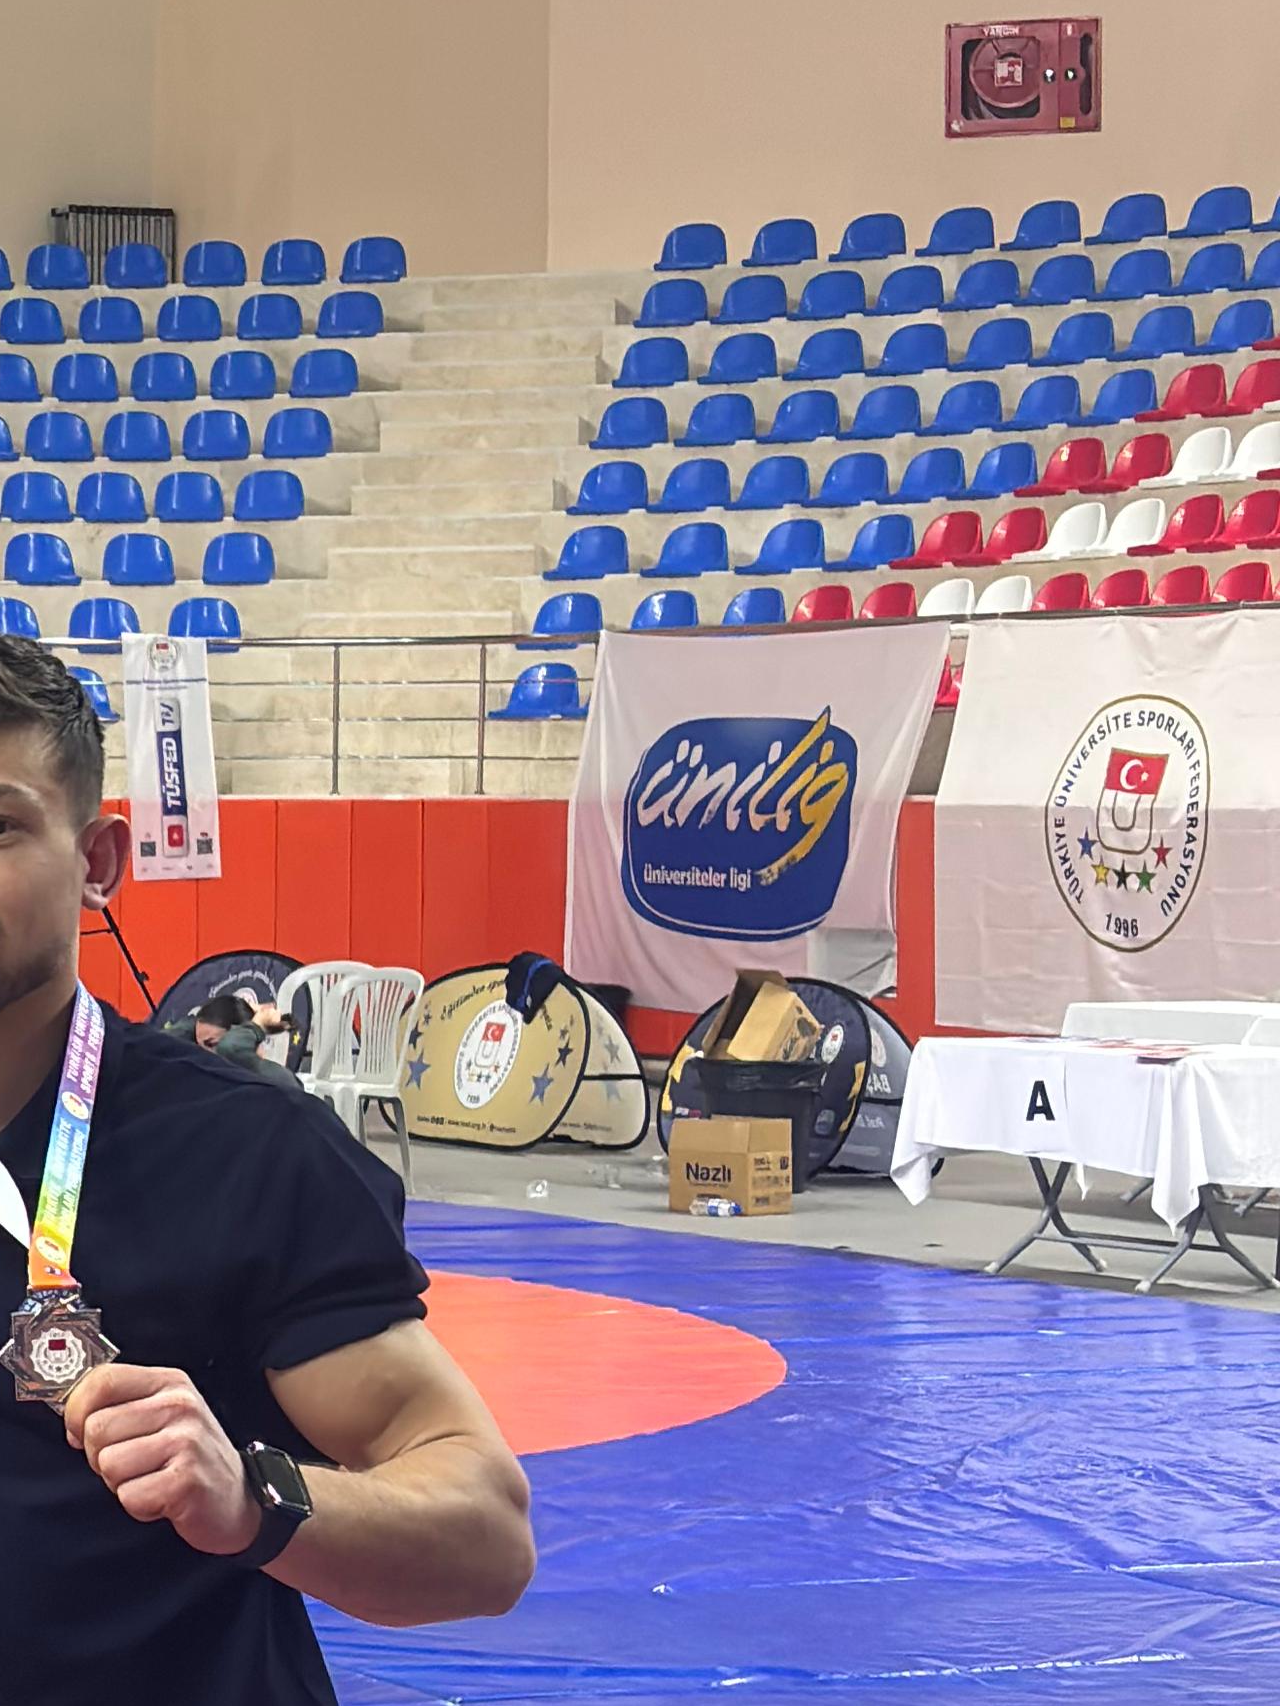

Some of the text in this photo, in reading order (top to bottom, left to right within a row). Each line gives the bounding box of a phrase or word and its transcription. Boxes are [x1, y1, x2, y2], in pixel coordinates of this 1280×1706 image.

[162, 736, 182, 808] TÜSFED
[1054, 710, 1201, 917] TÜRKİYE ÜNİVERSİTE SPORLARI FEDERASYONU
[643, 864, 752, 891] üniversiteler ligi
[1105, 913, 1139, 938] 1996
[1025, 1080, 1056, 1122] A
